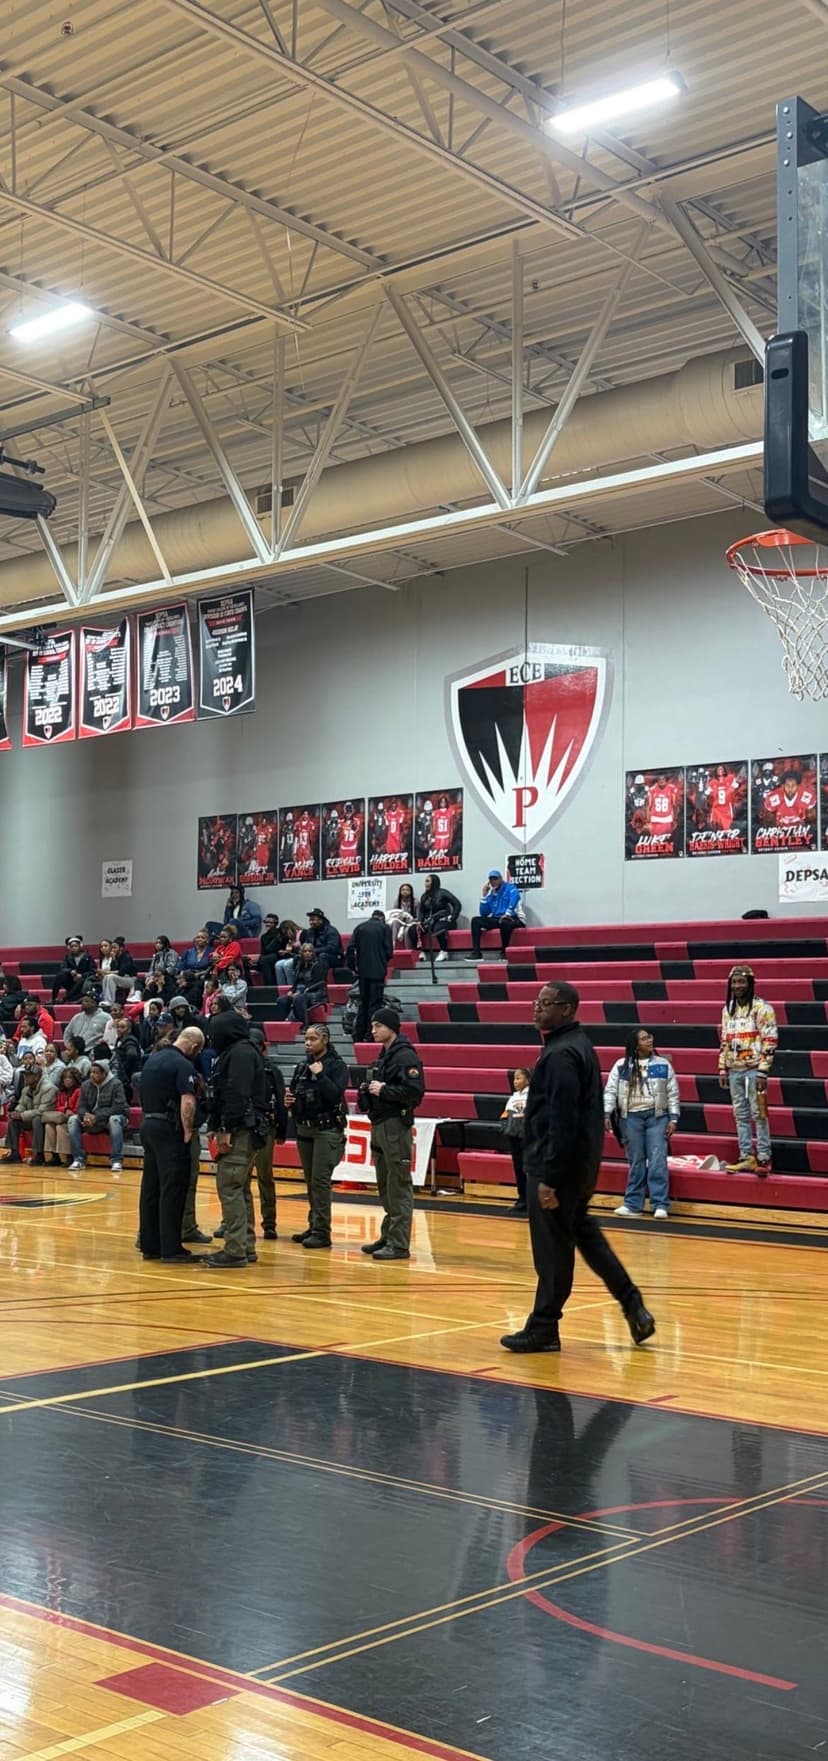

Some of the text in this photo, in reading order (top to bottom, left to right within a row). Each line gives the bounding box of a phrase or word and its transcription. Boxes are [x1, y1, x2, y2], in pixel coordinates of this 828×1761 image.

[509, 662, 542, 683] ECE
[213, 675, 243, 696] 2024
[149, 686, 180, 706] 2023
[93, 697, 120, 717] 2022
[35, 706, 62, 725] 2022
[512, 786, 539, 828] P
[756, 825, 811, 839] CHRISTIAN
[635, 842, 674, 854] GREEN
[755, 835, 812, 848] BENTLEY
[326, 863, 360, 874] LEWIS
[417, 857, 450, 867] BAKER
[514, 858, 536, 866] HOME
[515, 867, 537, 875] TEAM
[351, 878, 383, 888] UNIVERSITY
[511, 875, 541, 884] SECTION
